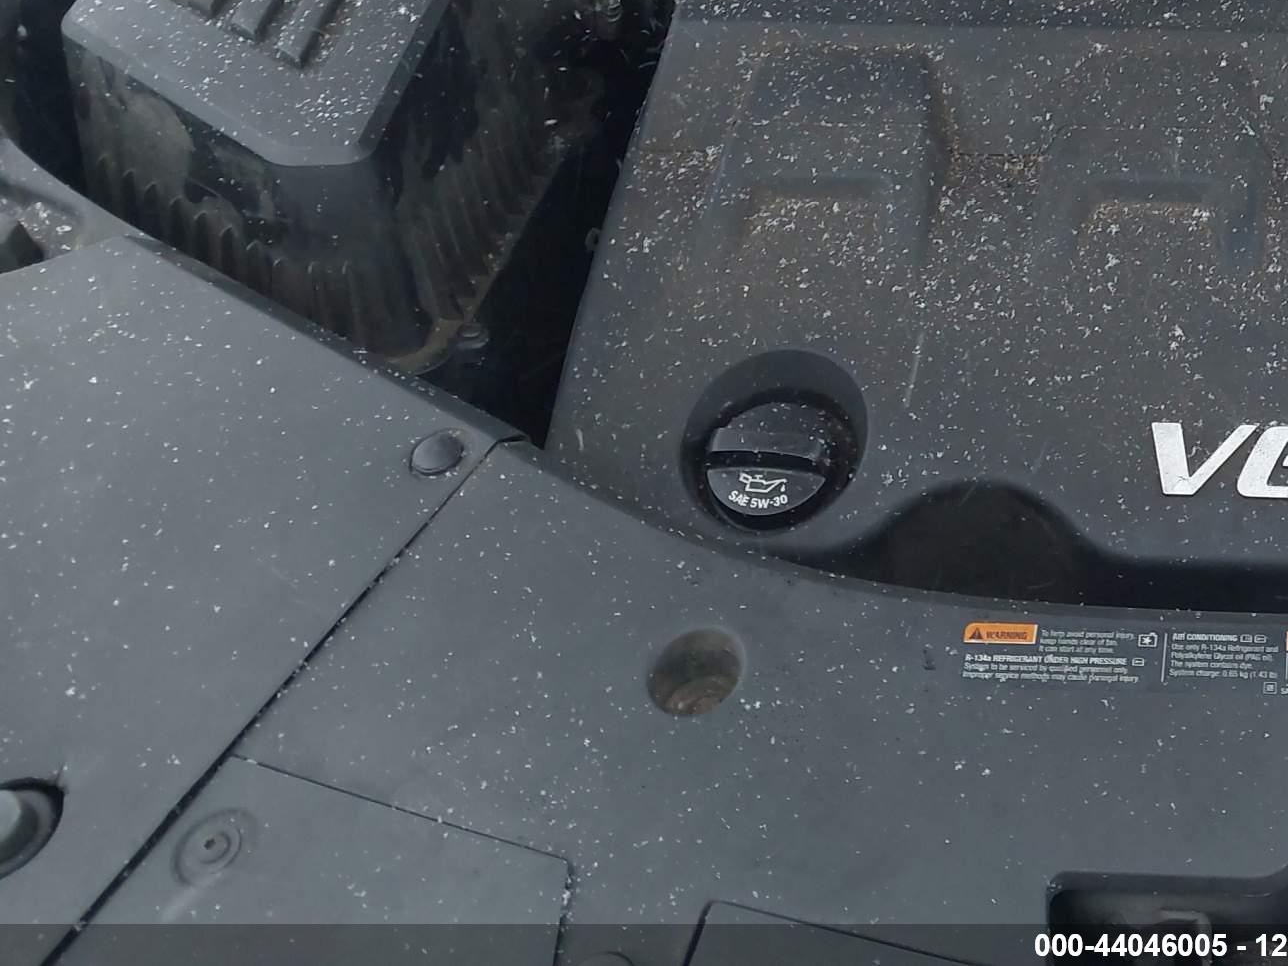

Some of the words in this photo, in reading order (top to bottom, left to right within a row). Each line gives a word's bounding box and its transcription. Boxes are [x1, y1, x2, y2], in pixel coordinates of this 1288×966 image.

[728, 490, 750, 507] SAE
[750, 494, 789, 509] 5W-30
[986, 631, 1028, 640] WARNING
